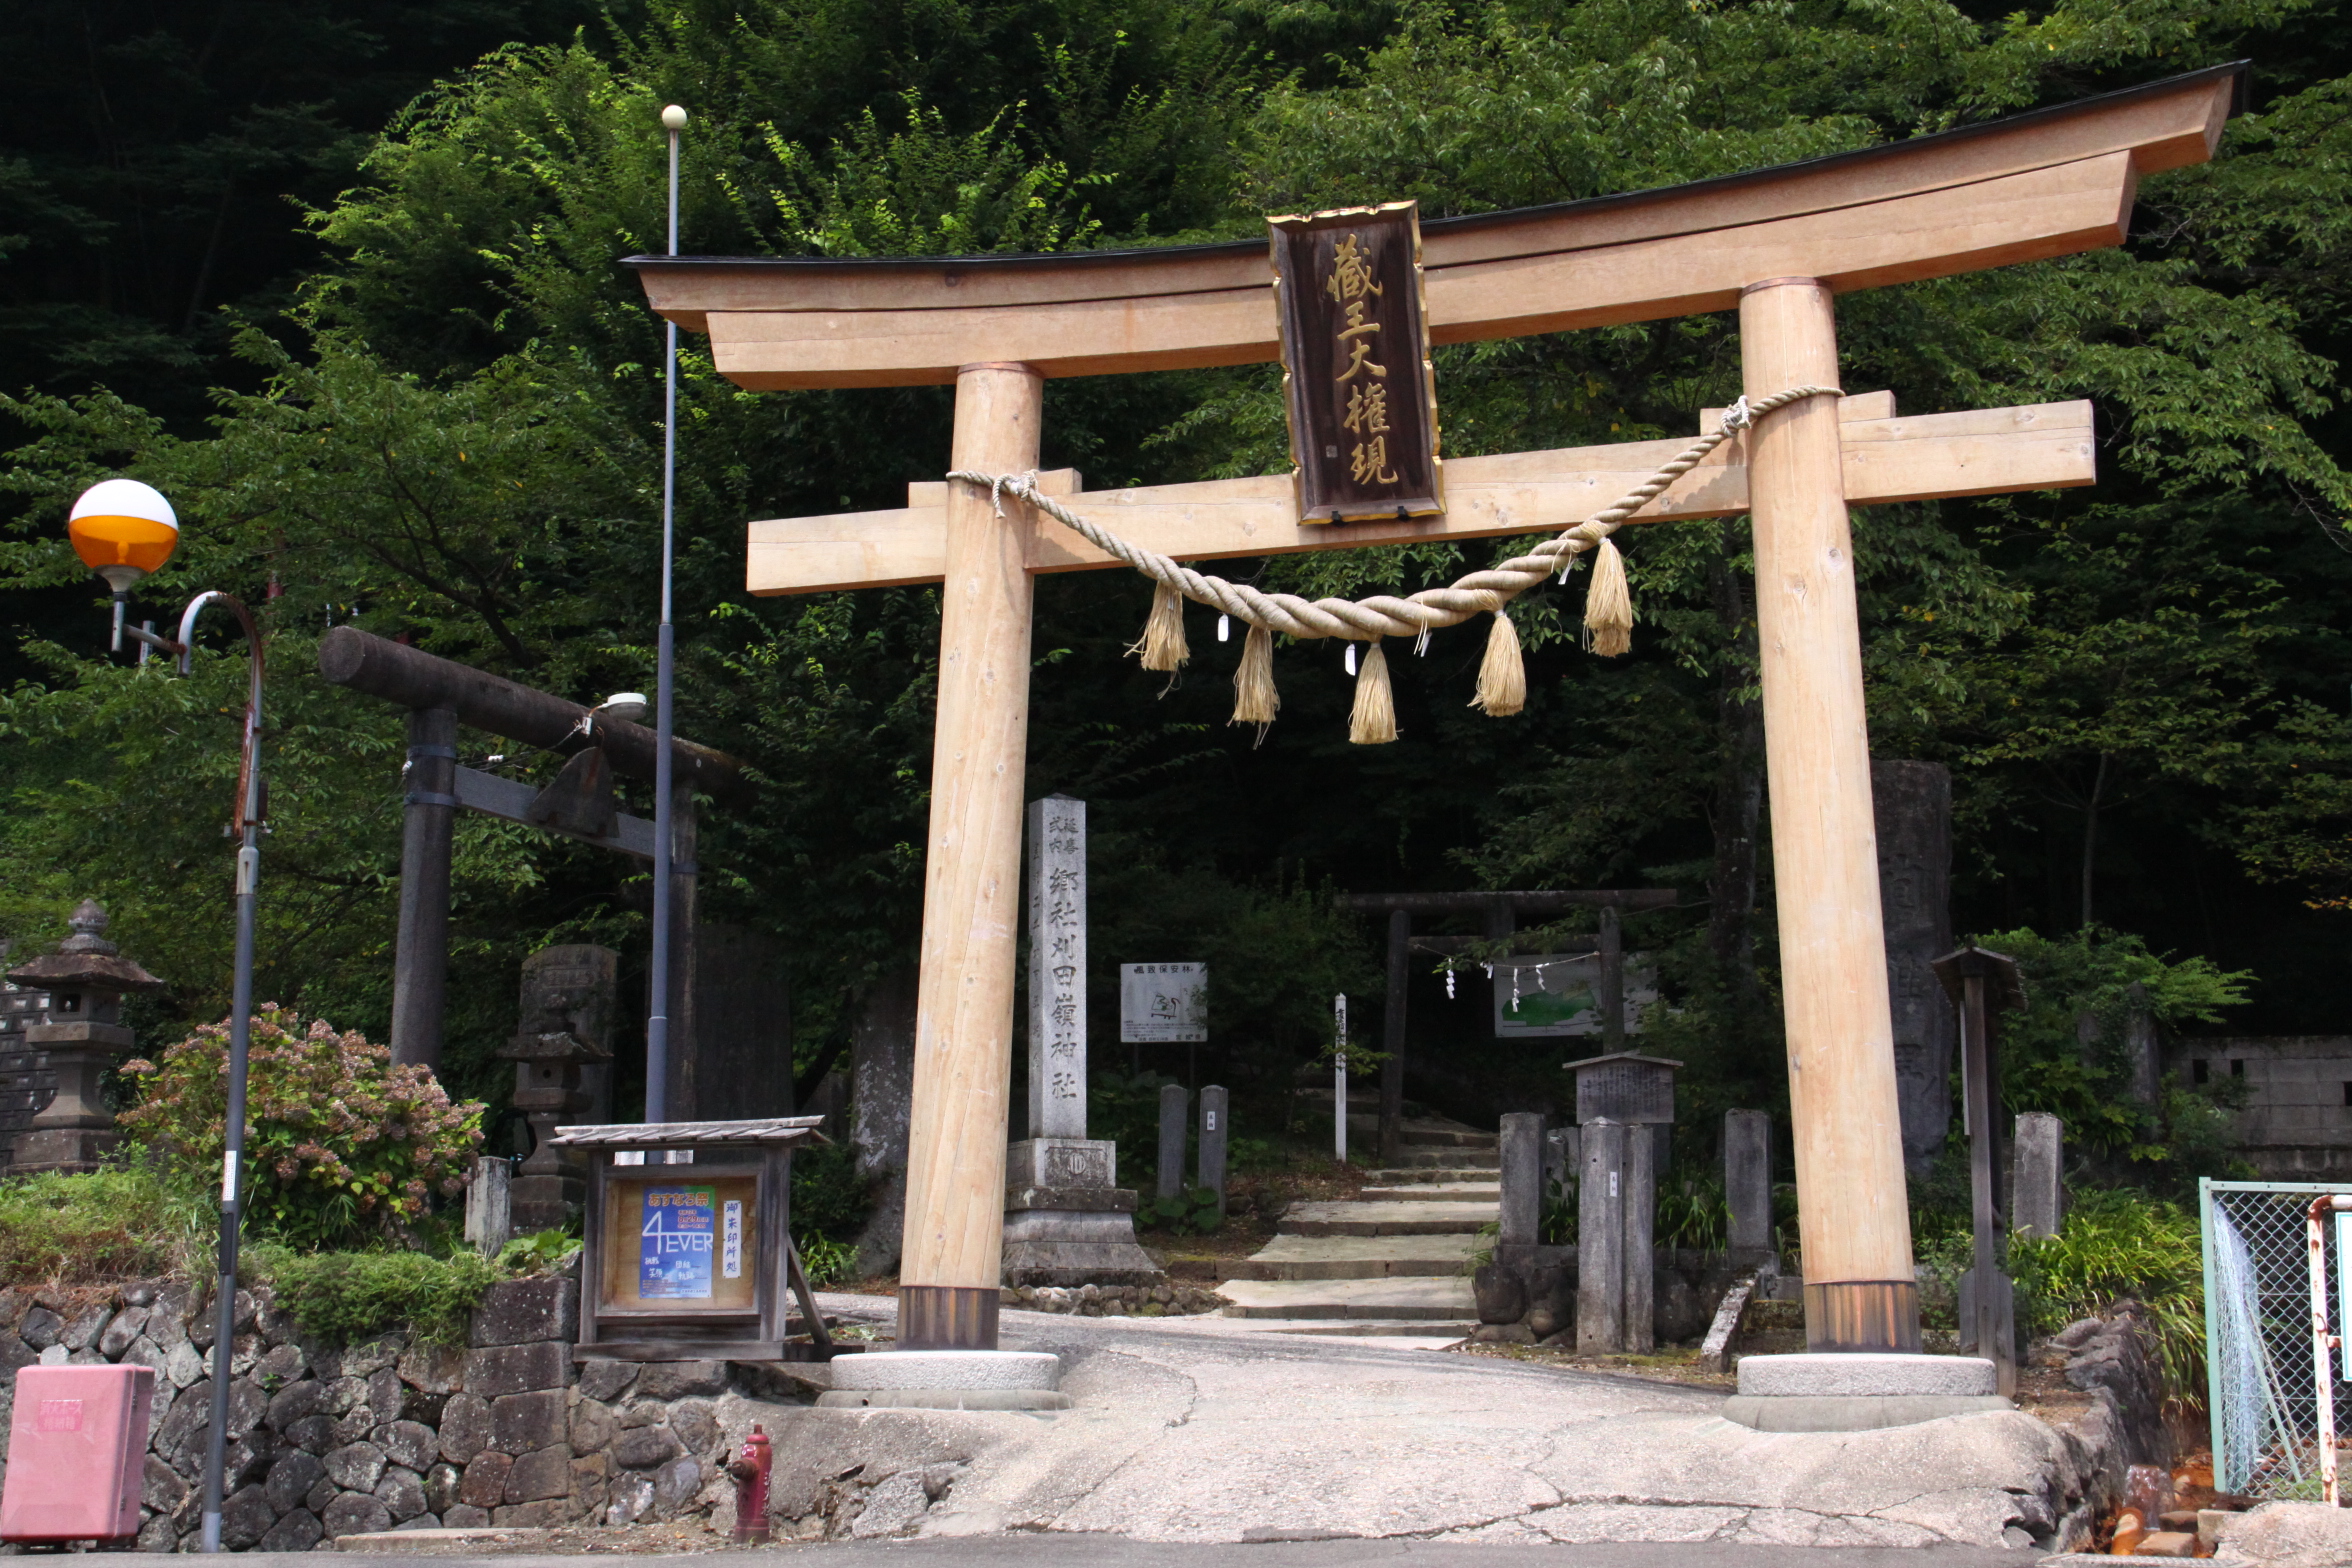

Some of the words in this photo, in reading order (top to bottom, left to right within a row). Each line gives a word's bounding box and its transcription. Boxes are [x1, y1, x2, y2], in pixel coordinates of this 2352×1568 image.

[648, 1192, 710, 1207] あすなろ祭
